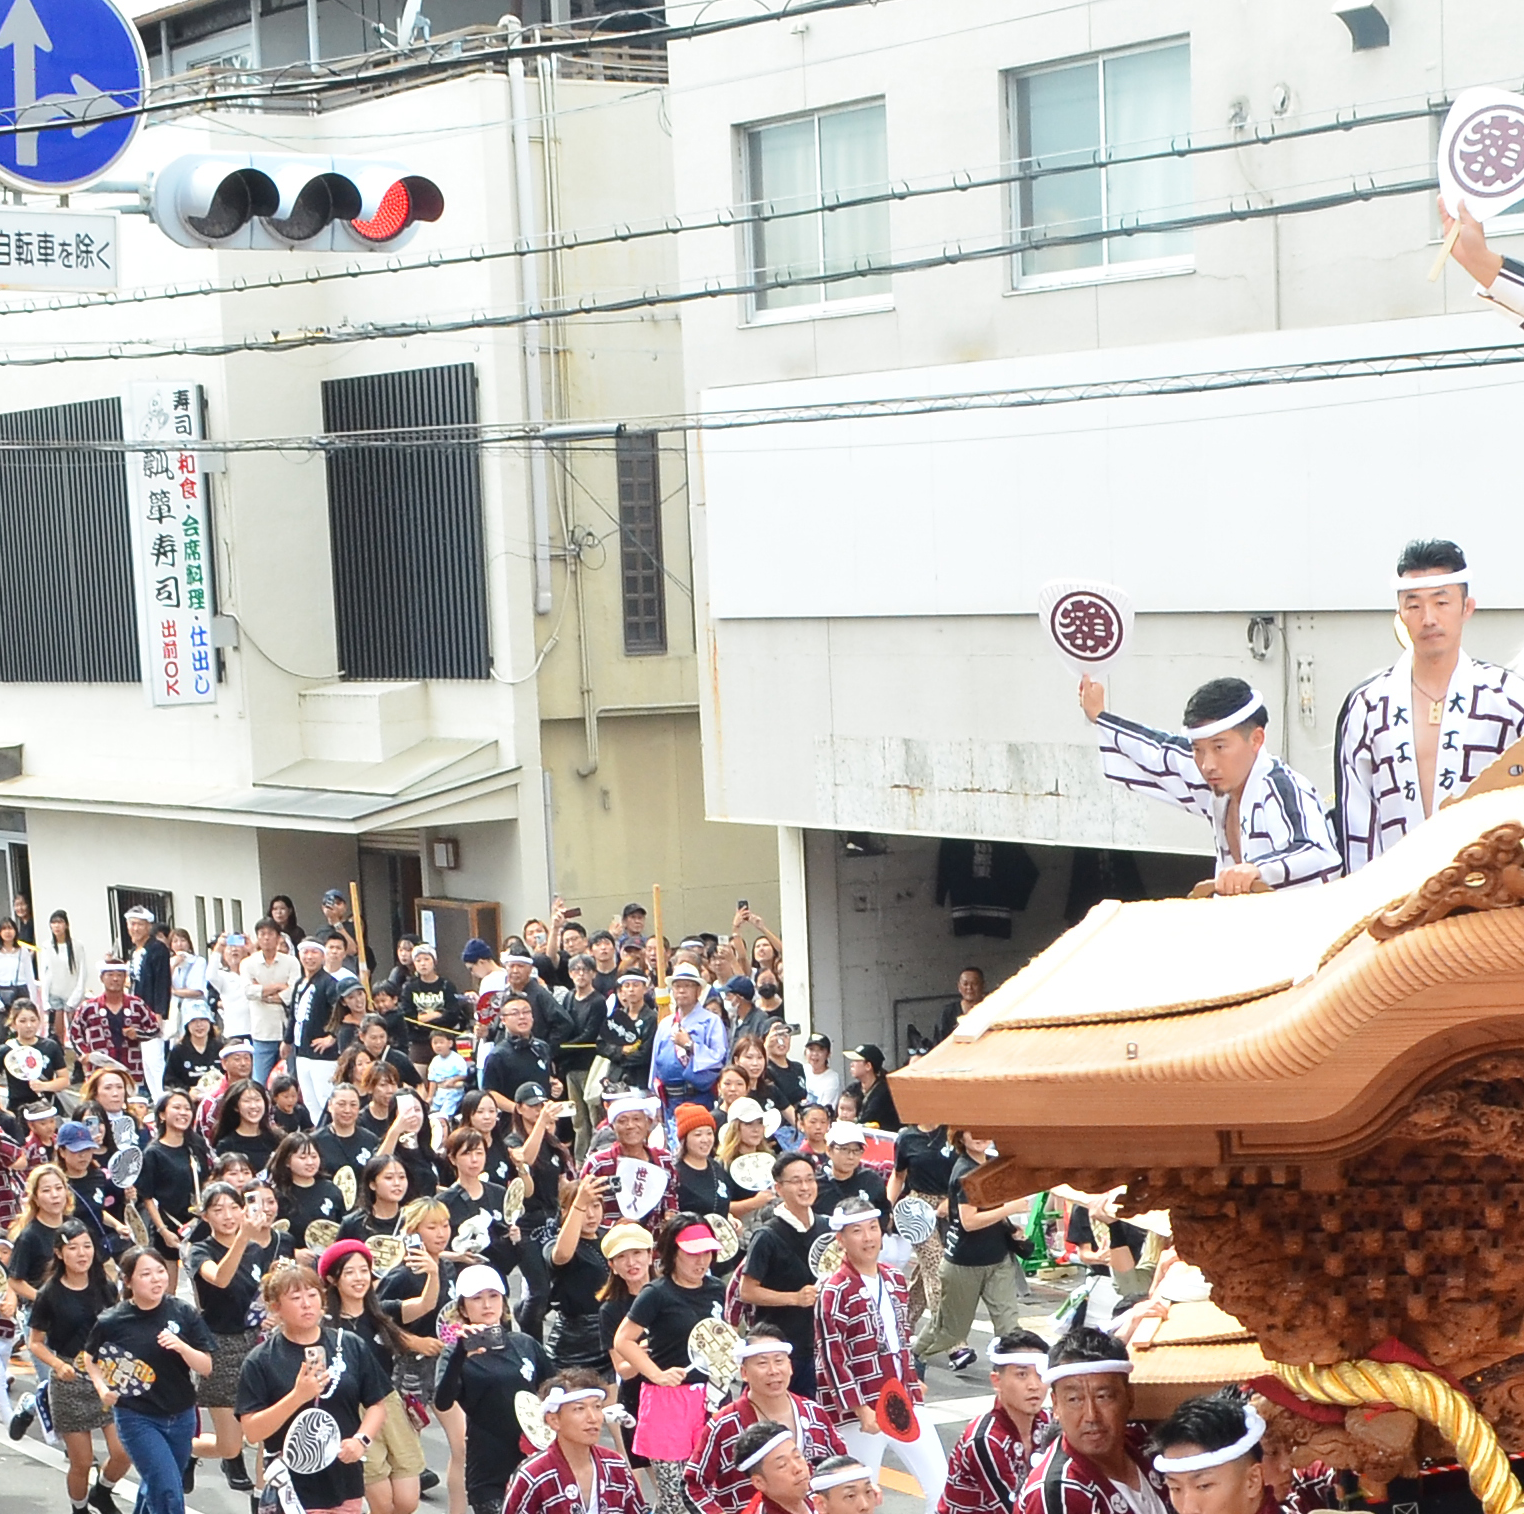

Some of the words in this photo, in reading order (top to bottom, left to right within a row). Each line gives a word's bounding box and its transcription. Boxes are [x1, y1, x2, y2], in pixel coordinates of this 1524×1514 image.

[1393, 705, 1417, 802] 大工方
[1439, 691, 1466, 791] 大工方
